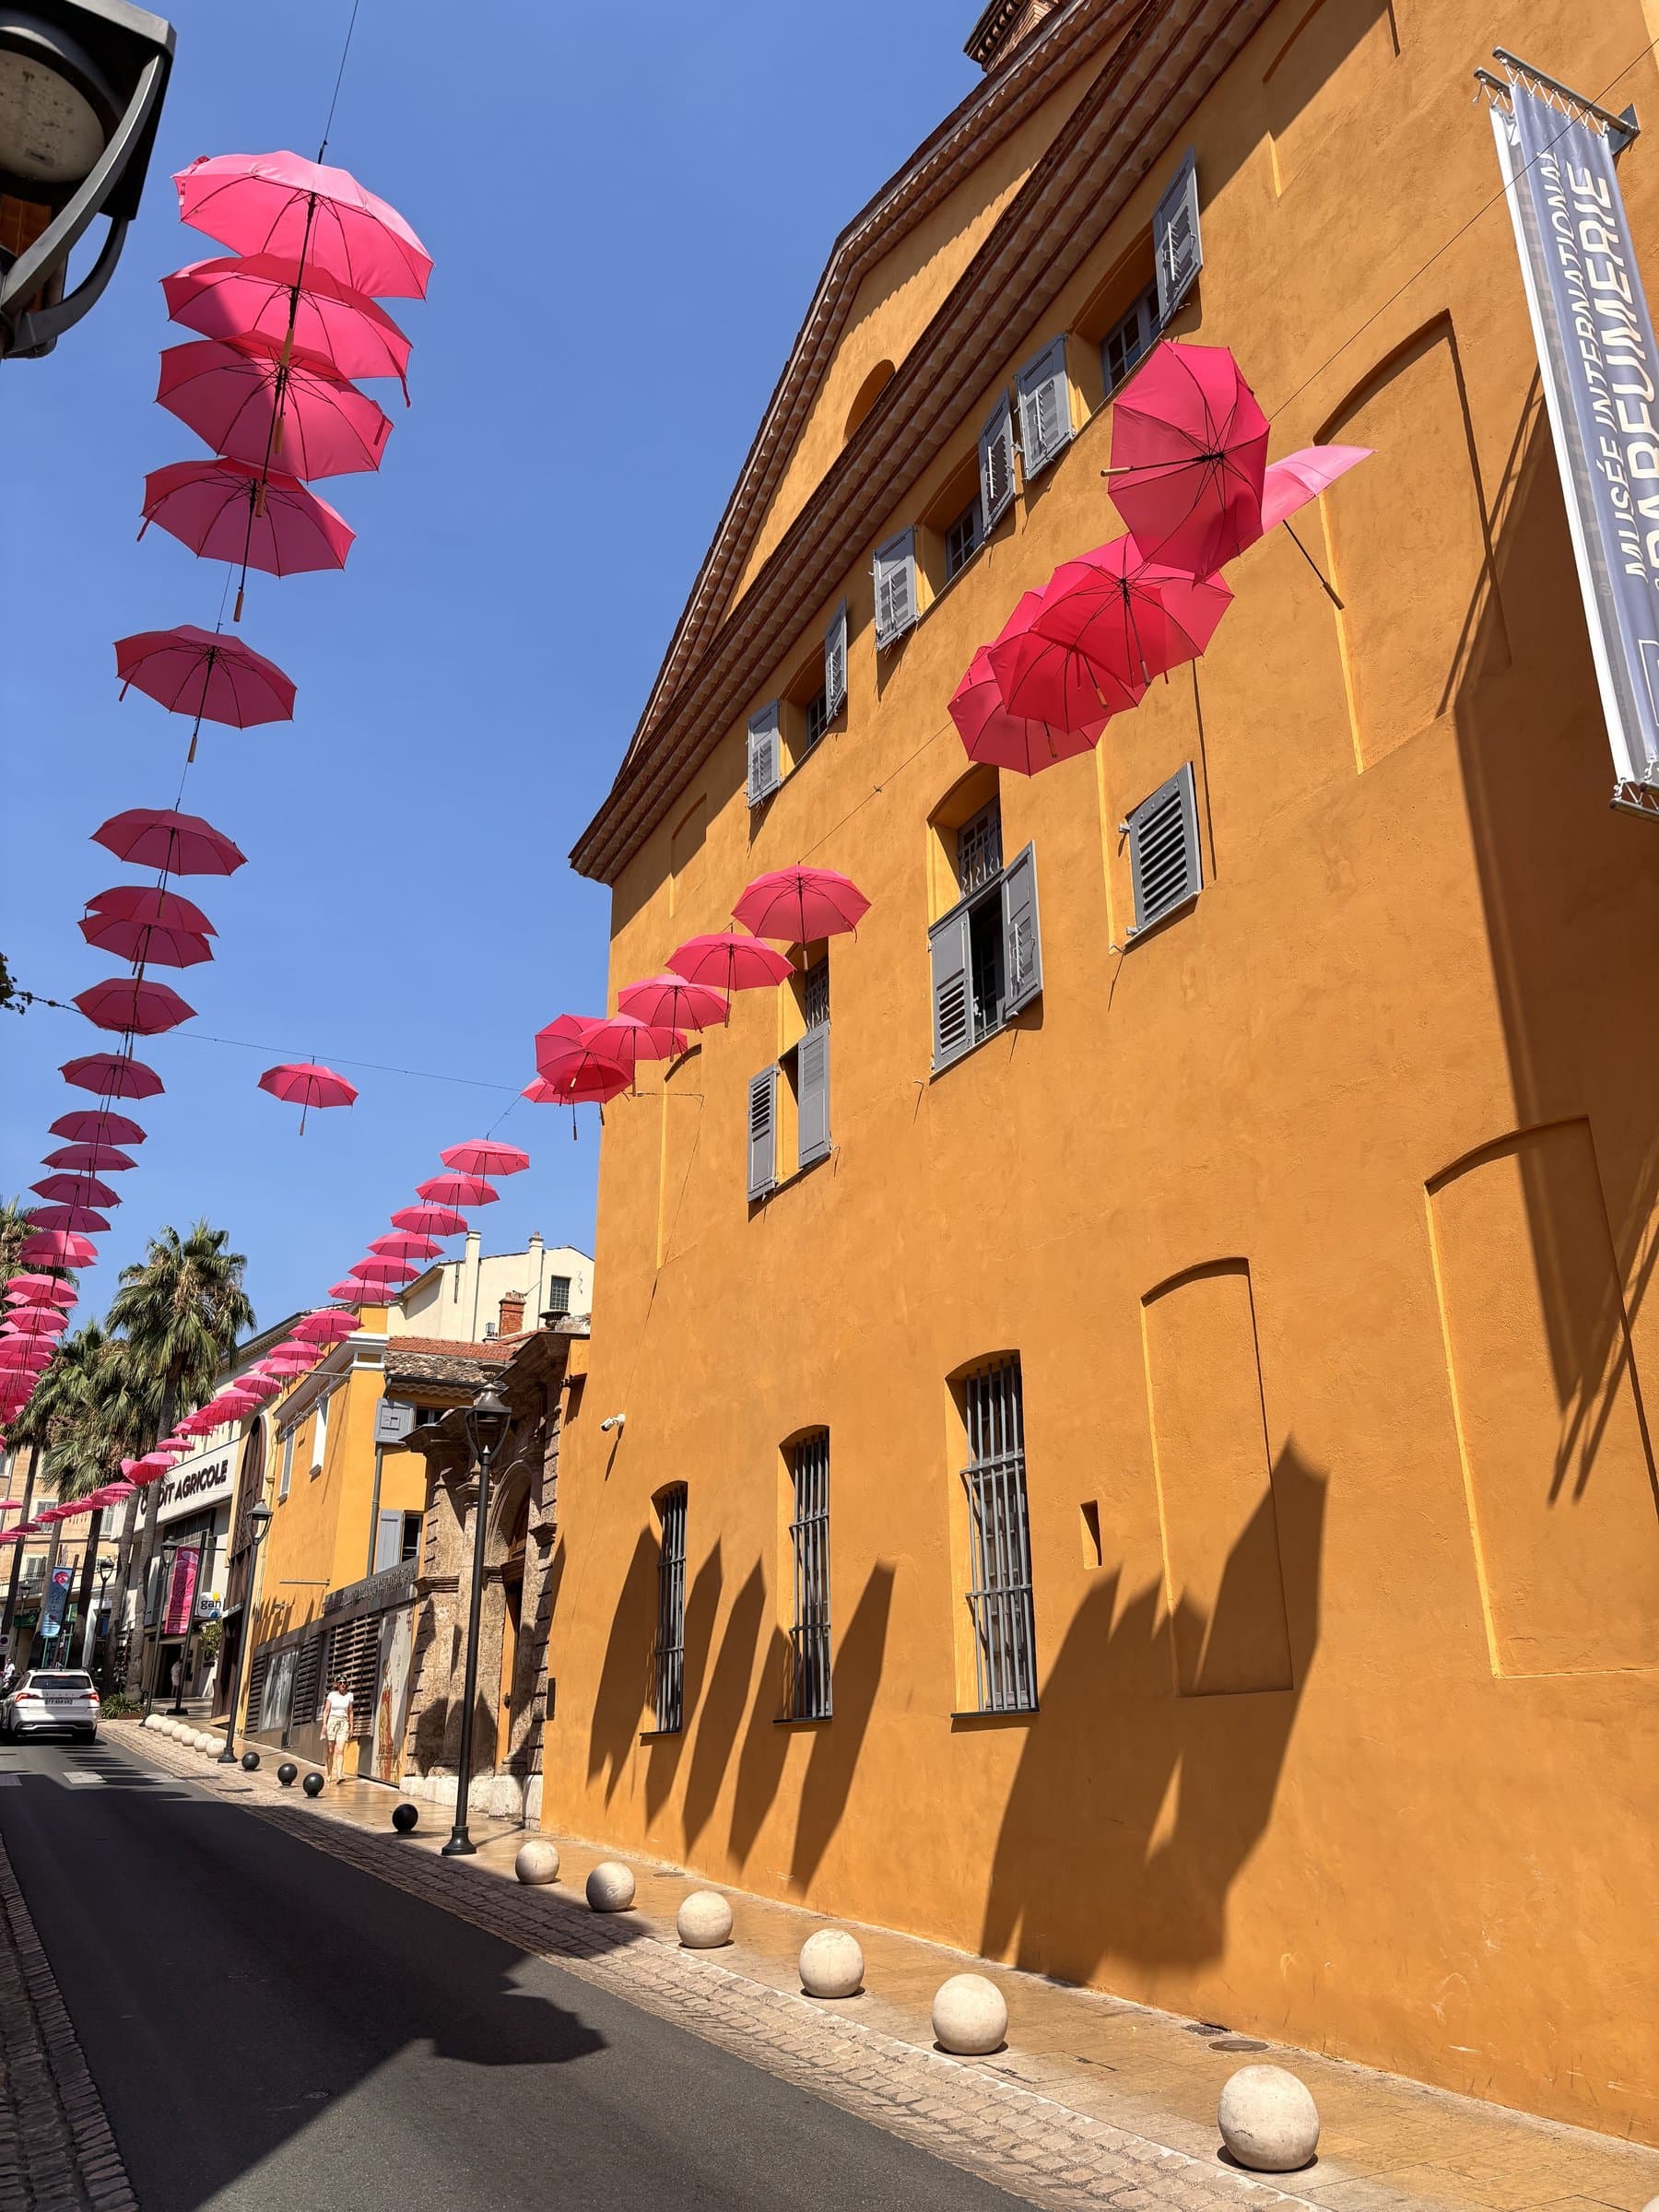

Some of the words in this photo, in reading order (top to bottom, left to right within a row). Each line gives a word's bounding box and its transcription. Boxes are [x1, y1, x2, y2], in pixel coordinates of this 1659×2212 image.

[1536, 150, 1618, 433] INTERNATIONAL
[1566, 159, 1659, 568] RFUMERIE
[1596, 436, 1648, 582] MUSÉE
[140, 1482, 175, 1515] CDIT
[174, 1460, 229, 1502] AGRICOLE
[200, 1600, 221, 1610] gan
